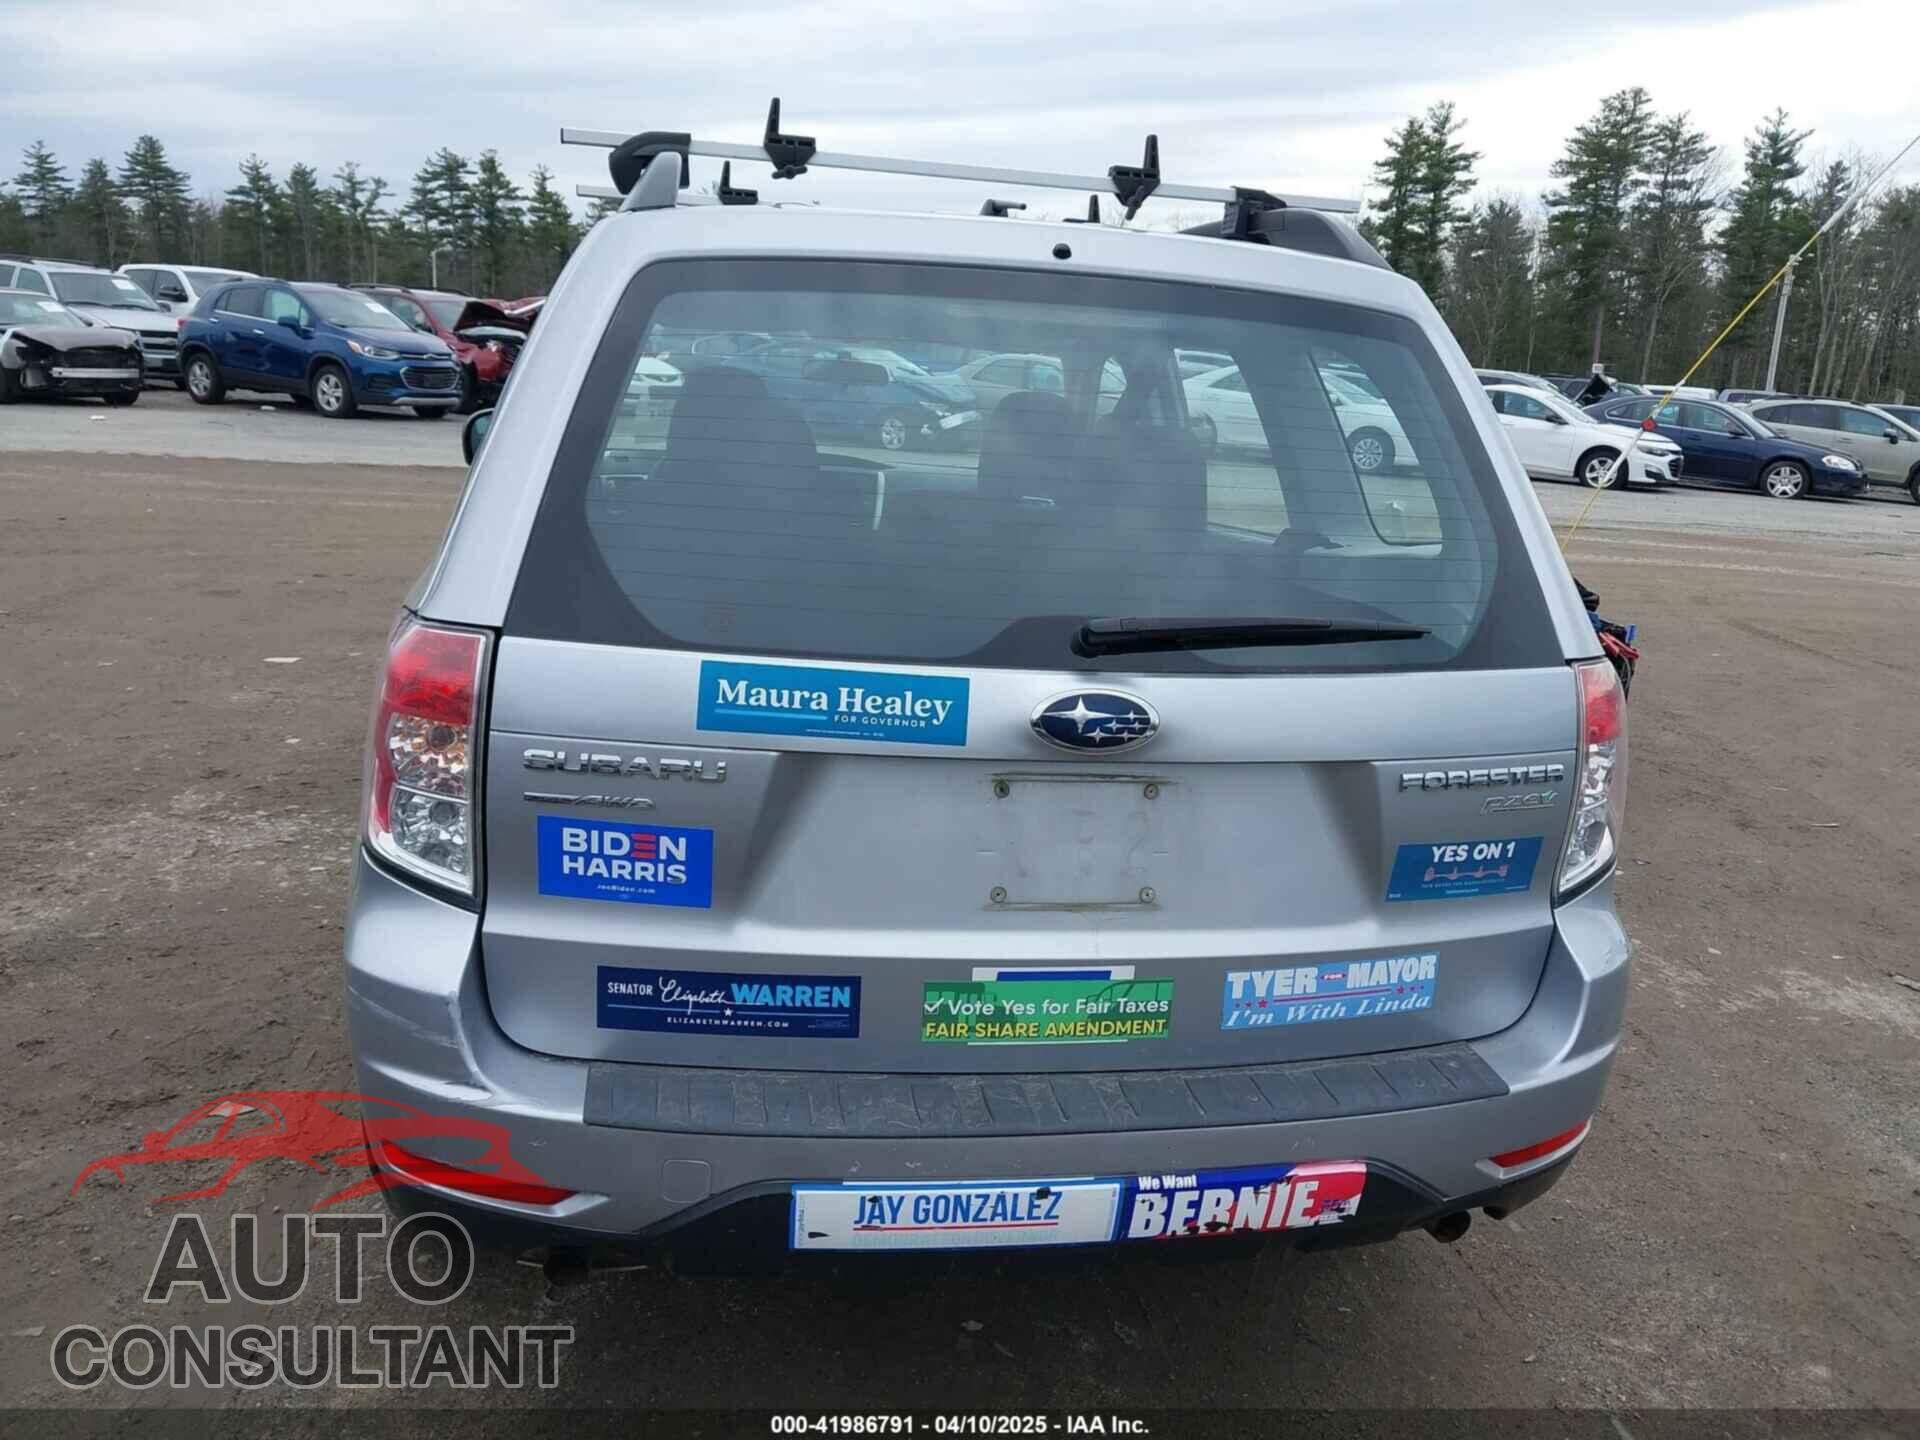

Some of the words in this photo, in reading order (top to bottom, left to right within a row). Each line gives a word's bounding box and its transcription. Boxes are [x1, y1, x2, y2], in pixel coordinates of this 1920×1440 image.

[716, 678, 828, 711] Maura
[836, 687, 953, 725] Healey
[834, 714, 857, 724] FOR
[862, 715, 927, 729] GOVERNOR
[523, 749, 727, 783] SUBARU
[1400, 764, 1565, 792] FORESTER
[562, 827, 687, 861] BIDEN
[1431, 843, 1469, 863] YES
[1473, 842, 1502, 861] ON
[1507, 841, 1516, 858] 1
[562, 855, 687, 885] HARRIS
[1227, 967, 1318, 999] TYER
[1346, 955, 1438, 989] MAYOR
[607, 981, 653, 996] SENATOR
[731, 983, 851, 1008] WARREN
[948, 1000, 995, 1016] Vote
[1002, 999, 1036, 1015] Yes
[1042, 998, 1069, 1015] for
[1075, 998, 1111, 1015] Fair
[1117, 998, 1169, 1014] Taxes
[667, 1017, 790, 1028] ELIZABETHWARREN.COM
[1226, 1009, 1274, 1027] I'm
[1287, 1002, 1347, 1023] With
[1357, 992, 1431, 1016] Linda
[926, 1022, 968, 1038] FAIR
[975, 1021, 1040, 1038] SHARE
[1045, 1019, 1167, 1037] AMENDMENT
[1138, 1176, 1161, 1191] We
[1162, 1174, 1197, 1190] Want
[853, 1195, 905, 1225] JAY
[1127, 1180, 1320, 1239] BERNIE
